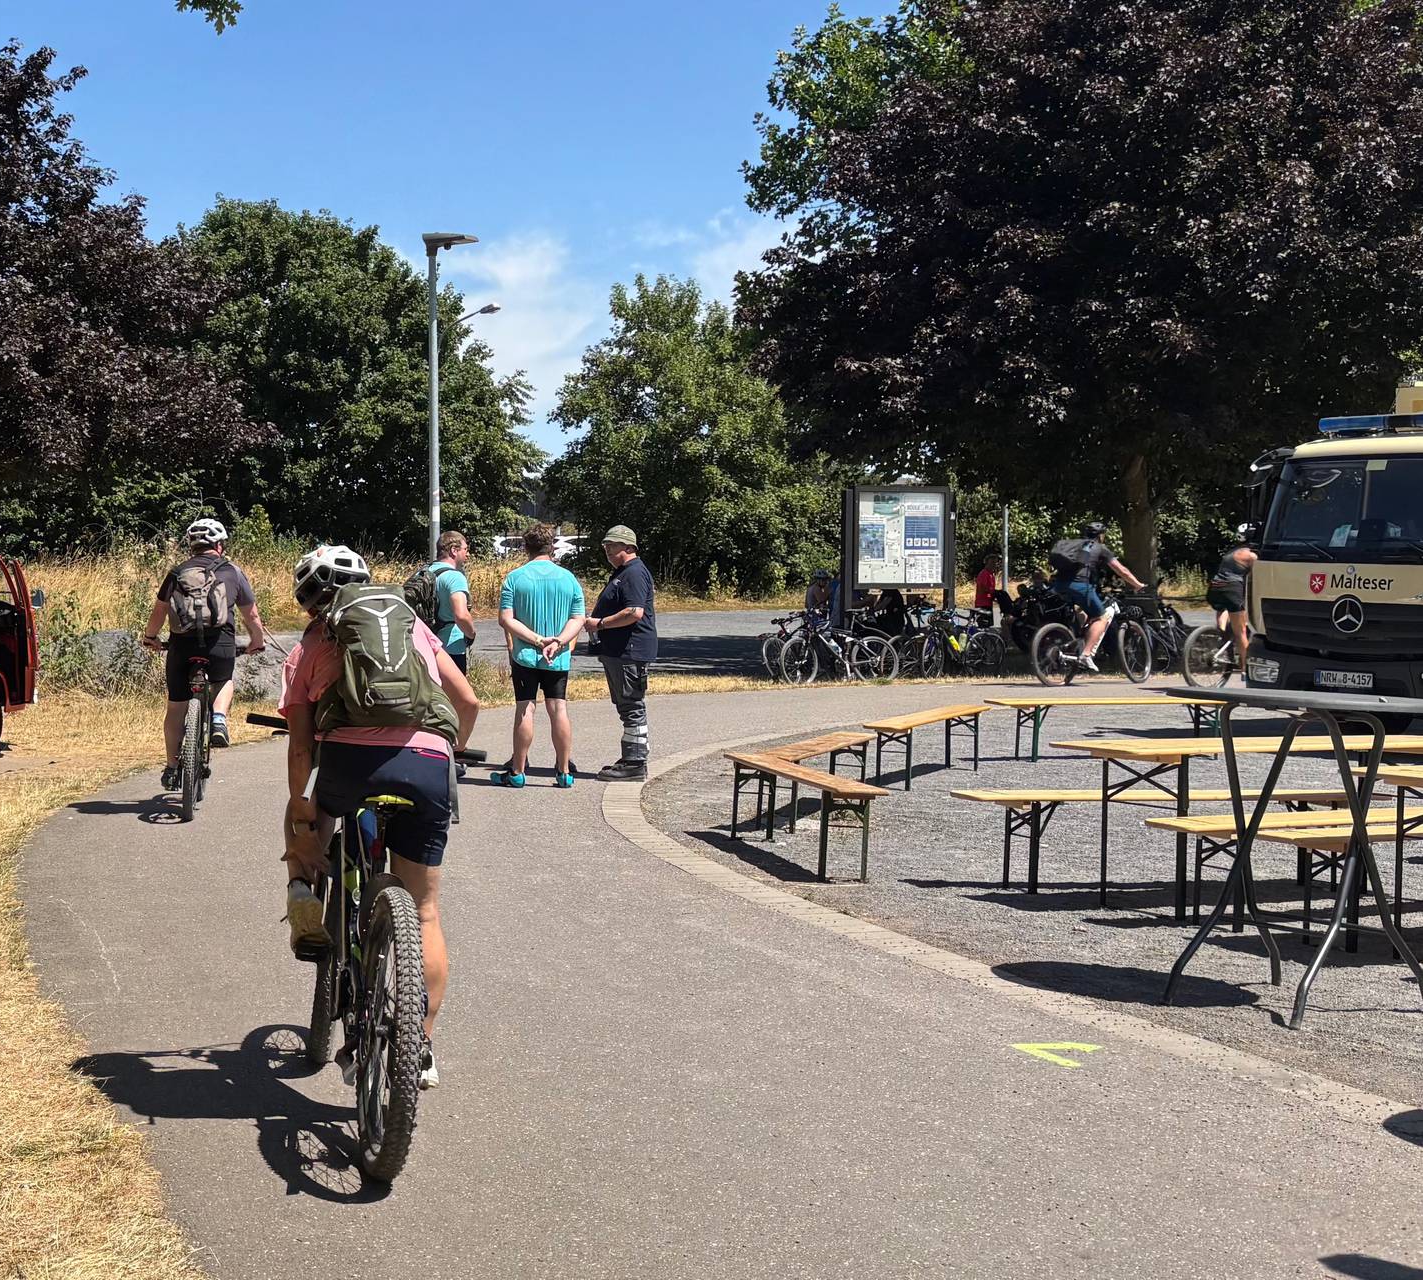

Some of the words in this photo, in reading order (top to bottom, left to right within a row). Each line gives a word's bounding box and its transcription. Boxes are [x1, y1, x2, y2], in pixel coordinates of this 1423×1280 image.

[1330, 574, 1394, 591] Malteser
[1321, 672, 1337, 684] NRW
[1342, 673, 1373, 687] 8-4157
